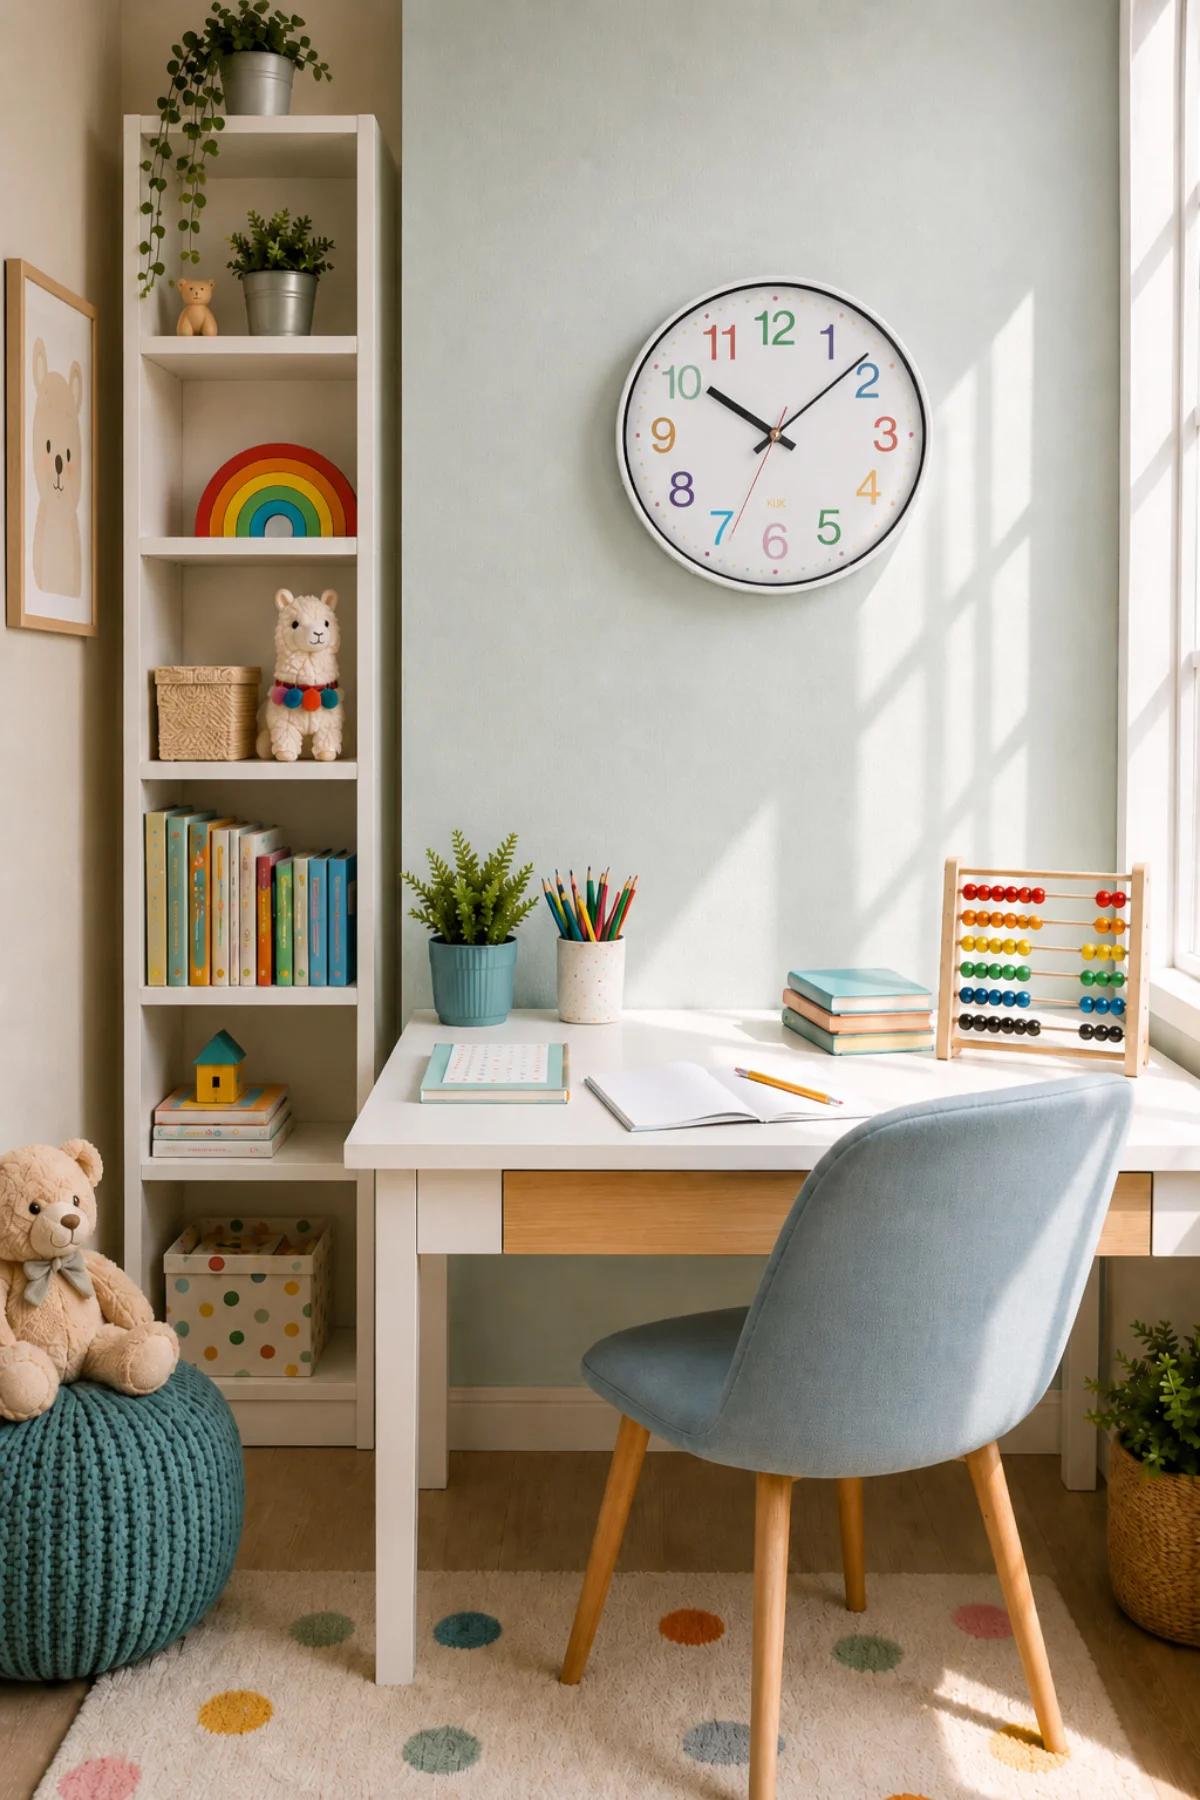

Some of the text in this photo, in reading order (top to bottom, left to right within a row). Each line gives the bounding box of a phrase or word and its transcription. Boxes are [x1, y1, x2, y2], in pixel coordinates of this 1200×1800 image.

[703, 324, 736, 360] 11
[754, 310, 795, 346] 12
[820, 324, 835, 360] 1
[662, 364, 702, 400] 10
[855, 362, 880, 398] 2
[651, 417, 676, 454] 9
[873, 416, 898, 452] 3
[669, 471, 695, 508] 8
[855, 469, 882, 505] 4
[710, 510, 734, 546] 7
[762, 523, 789, 560] 6
[817, 509, 842, 546] 5
